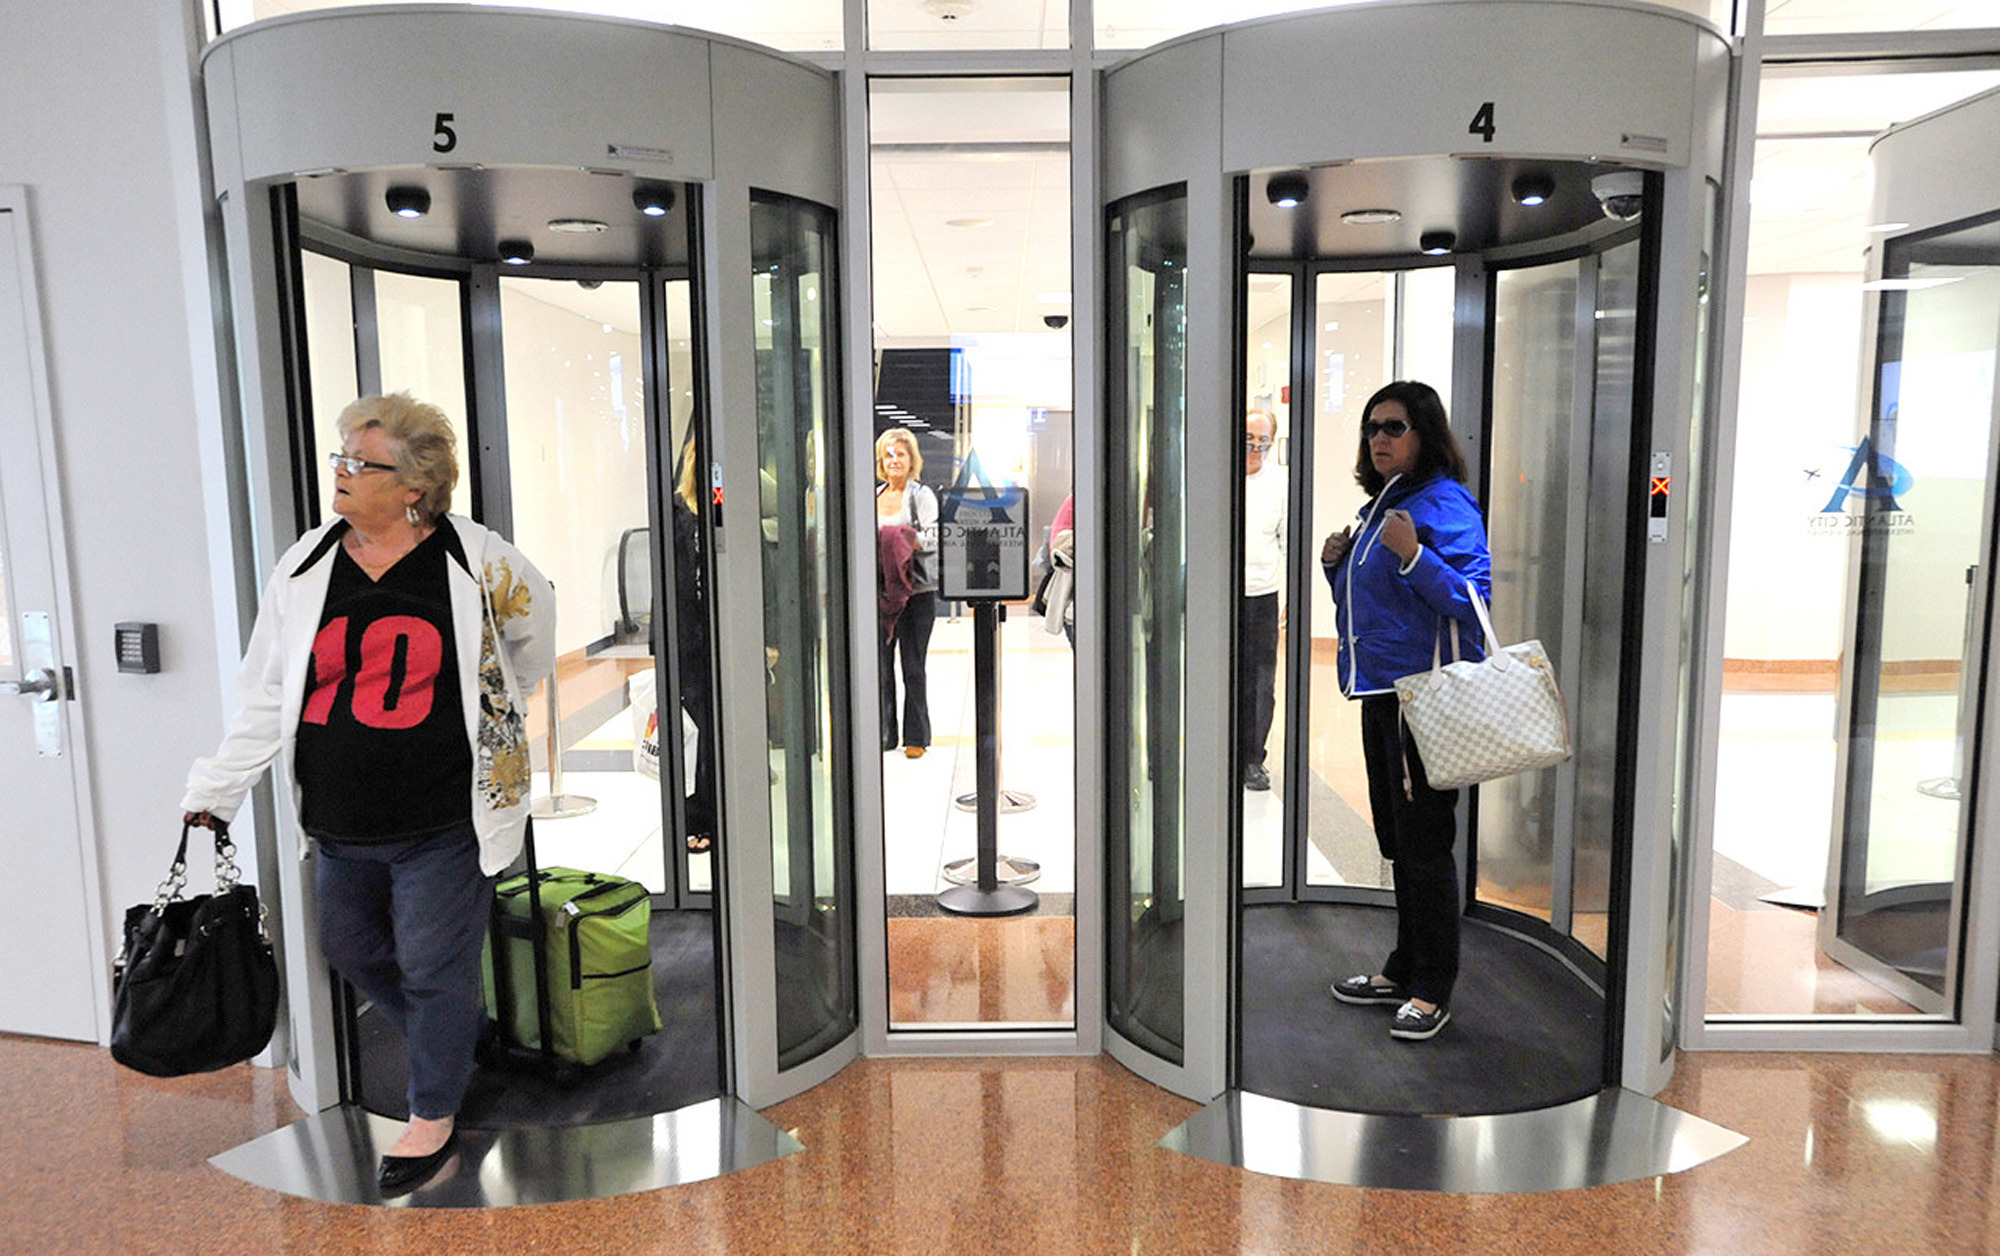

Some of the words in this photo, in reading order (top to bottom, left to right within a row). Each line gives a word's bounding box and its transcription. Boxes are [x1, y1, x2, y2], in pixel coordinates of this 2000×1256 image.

[434, 112, 457, 153] 5
[1469, 102, 1496, 142] 4
[302, 615, 443, 730] 10
